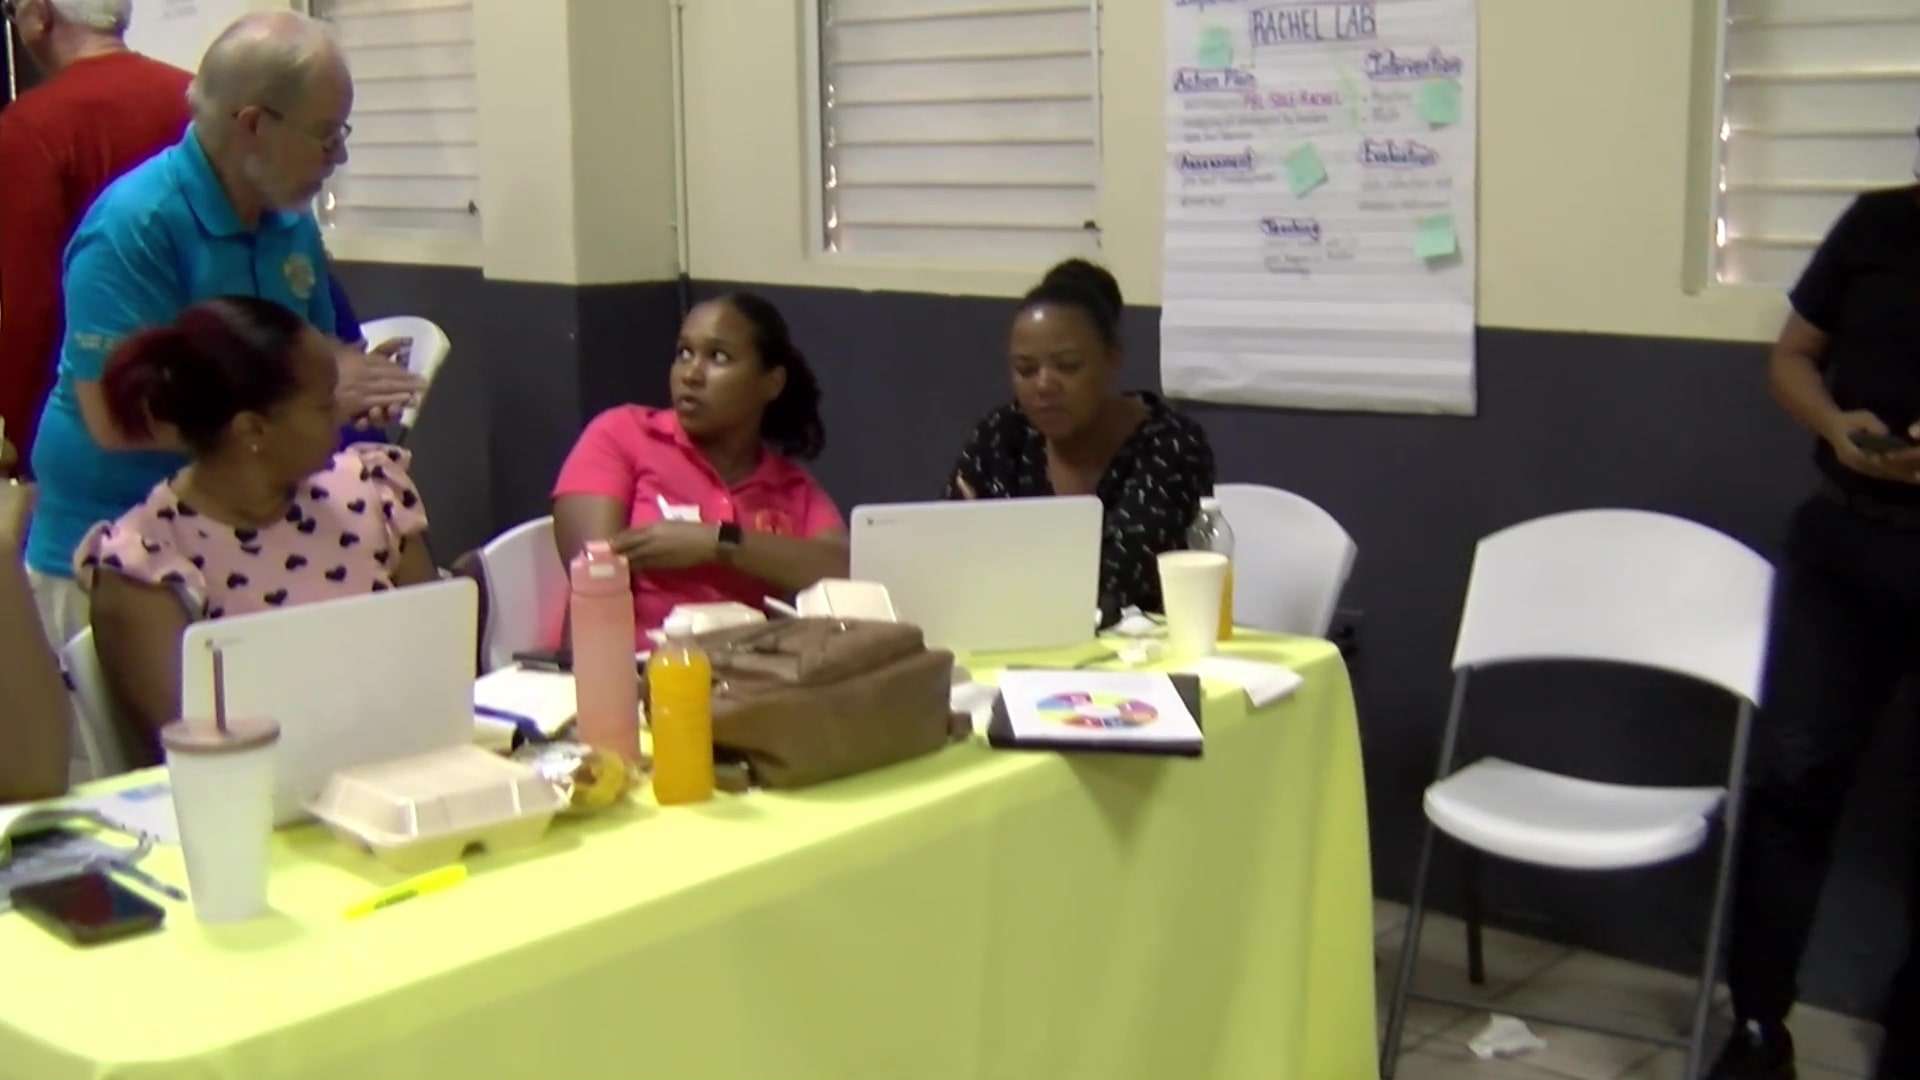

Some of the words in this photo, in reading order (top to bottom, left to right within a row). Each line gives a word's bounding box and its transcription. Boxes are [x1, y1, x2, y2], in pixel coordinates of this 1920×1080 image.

[1252, 8, 1323, 43] RACHEL
[1335, 5, 1376, 40] LAB
[1174, 70, 1220, 92] Action
[1181, 149, 1253, 170] Assessment
[1364, 142, 1436, 167] Evaluation
[1261, 218, 1320, 241] Teaching
